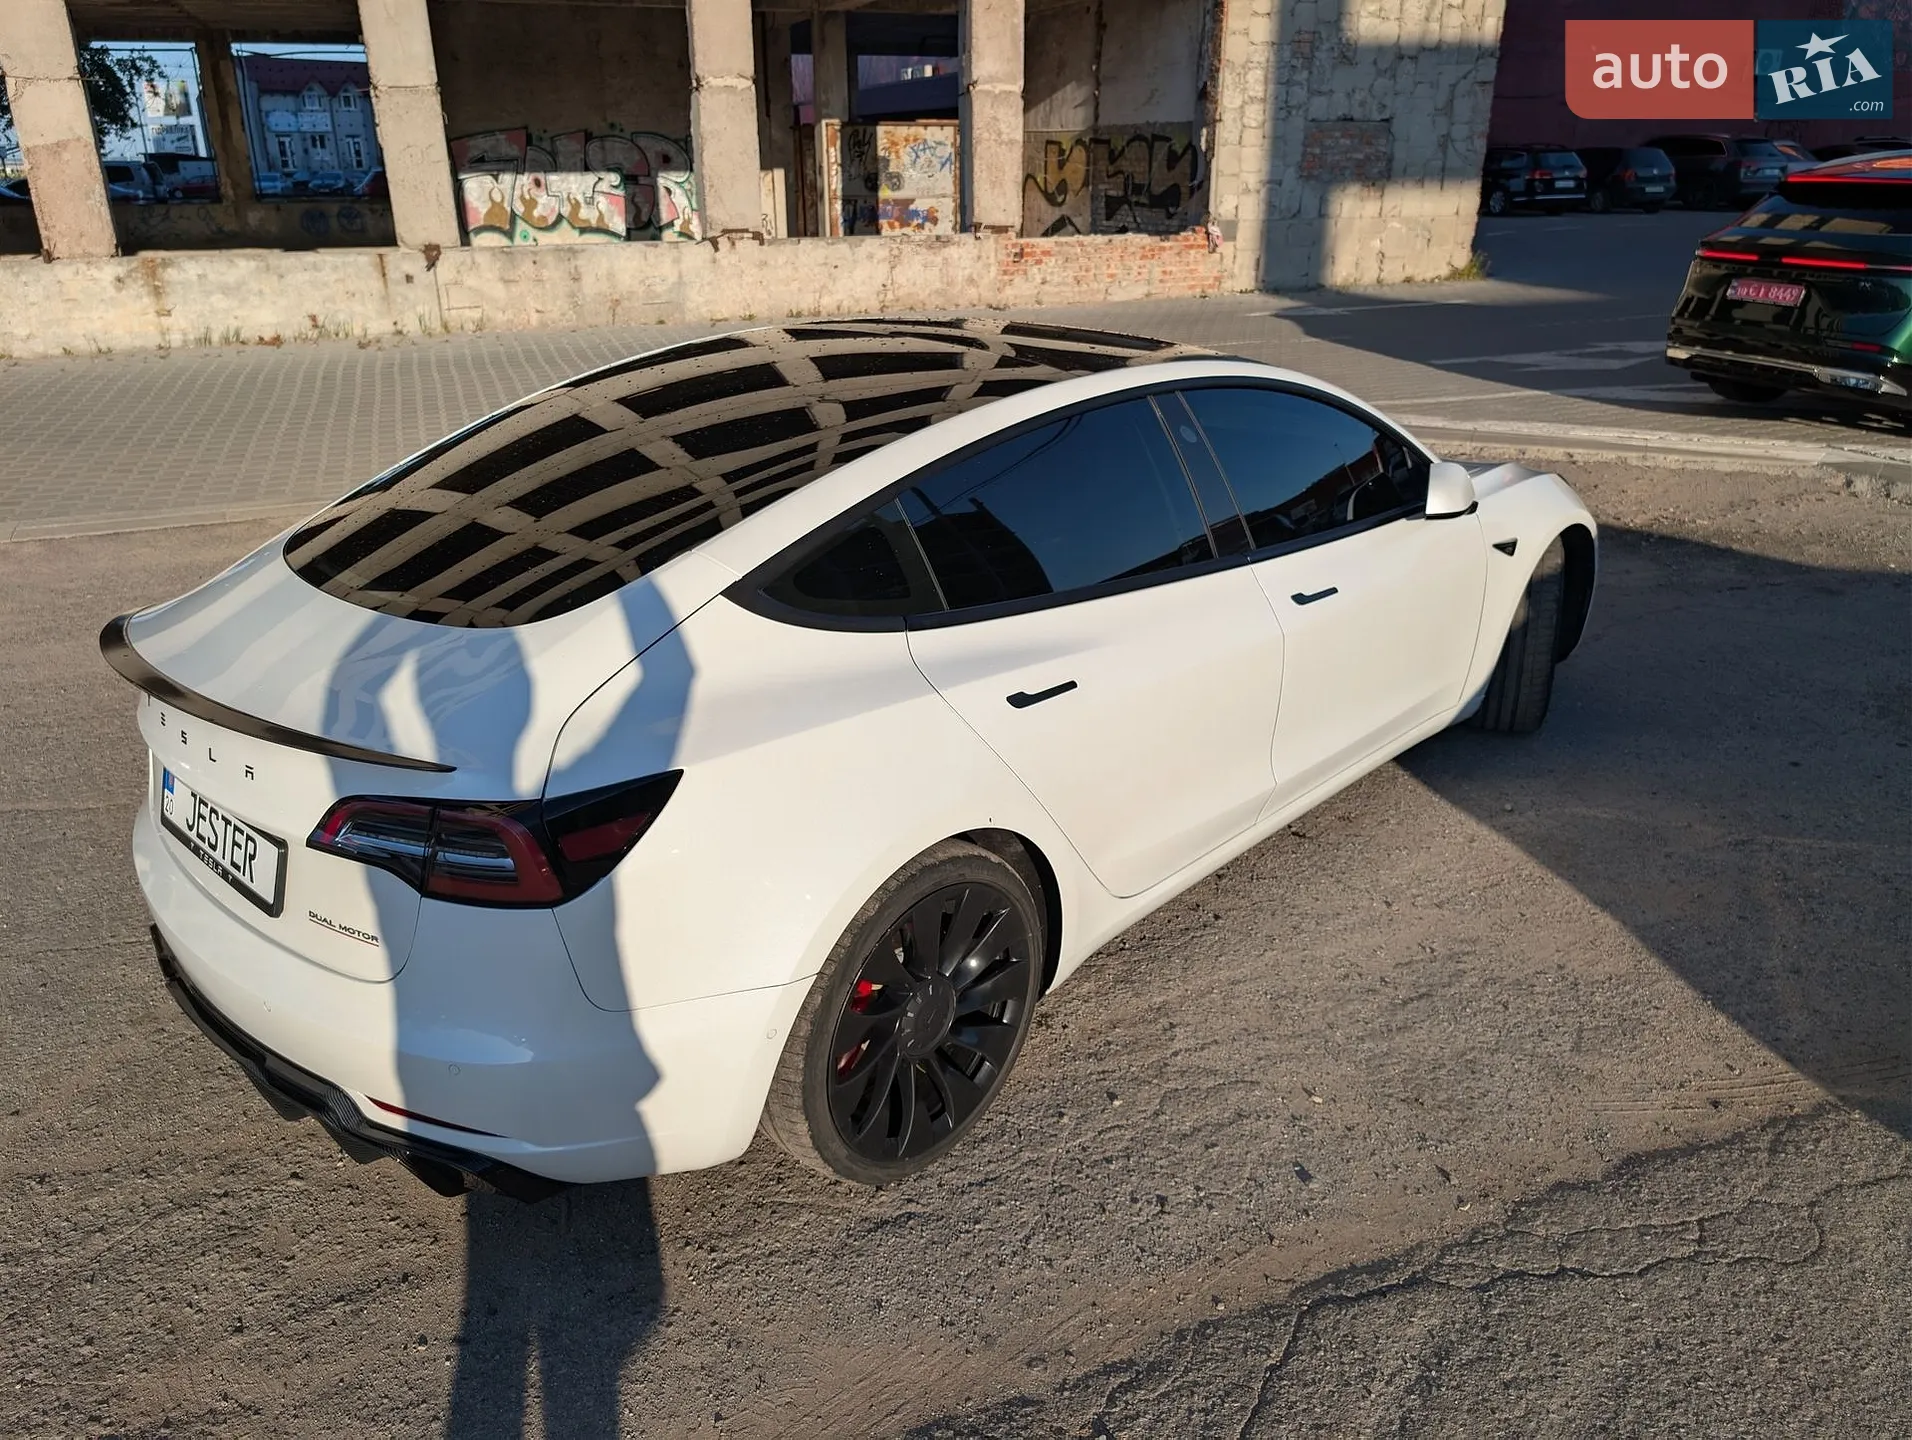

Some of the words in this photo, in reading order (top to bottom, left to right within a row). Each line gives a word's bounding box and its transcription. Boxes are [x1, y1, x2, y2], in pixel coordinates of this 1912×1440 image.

[164, 794, 175, 816] 20
[185, 790, 258, 884] JESTER
[198, 849, 224, 877] TESLA
[308, 909, 337, 929] DUAL
[338, 923, 380, 944] MOTOR
